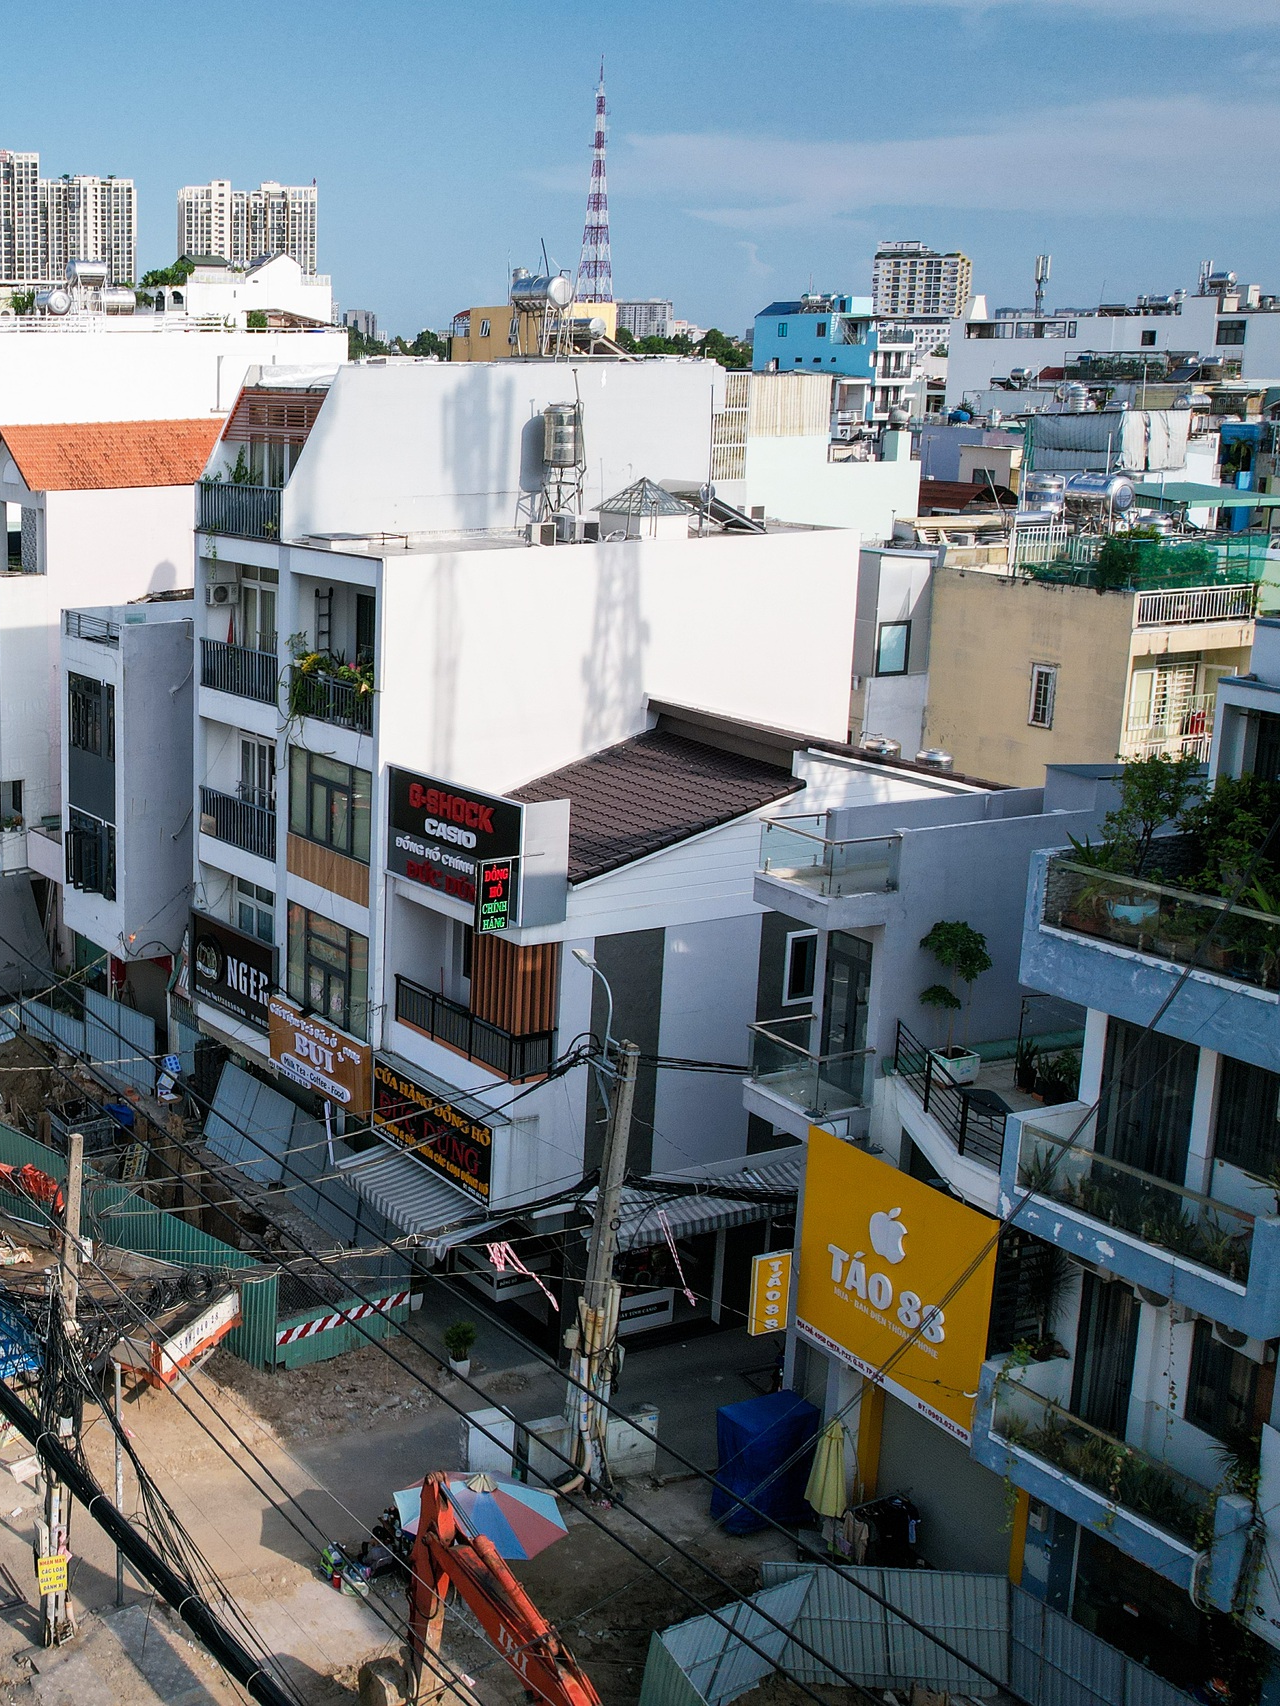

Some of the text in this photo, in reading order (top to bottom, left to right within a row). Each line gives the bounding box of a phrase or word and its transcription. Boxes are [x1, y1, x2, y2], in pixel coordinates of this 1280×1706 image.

[408, 783, 495, 834] G-SHOCK
[424, 817, 477, 850] CASIO
[395, 835, 475, 875] ĐỒNG HỒ CHÍNH
[482, 899, 508, 914] CHÍNH
[489, 880, 503, 898] HỒ
[294, 1032, 334, 1074] BỤI
[296, 1063, 306, 1077] Tea
[309, 1072, 329, 1090] Coffee
[331, 1085, 344, 1100] Food
[374, 1066, 490, 1146] CỬA HÀNG ĐỒNG HỒ
[766, 1260, 783, 1302] TÁO
[827, 1243, 945, 1344] TÁO 88
[834, 1286, 849, 1302] MUA
